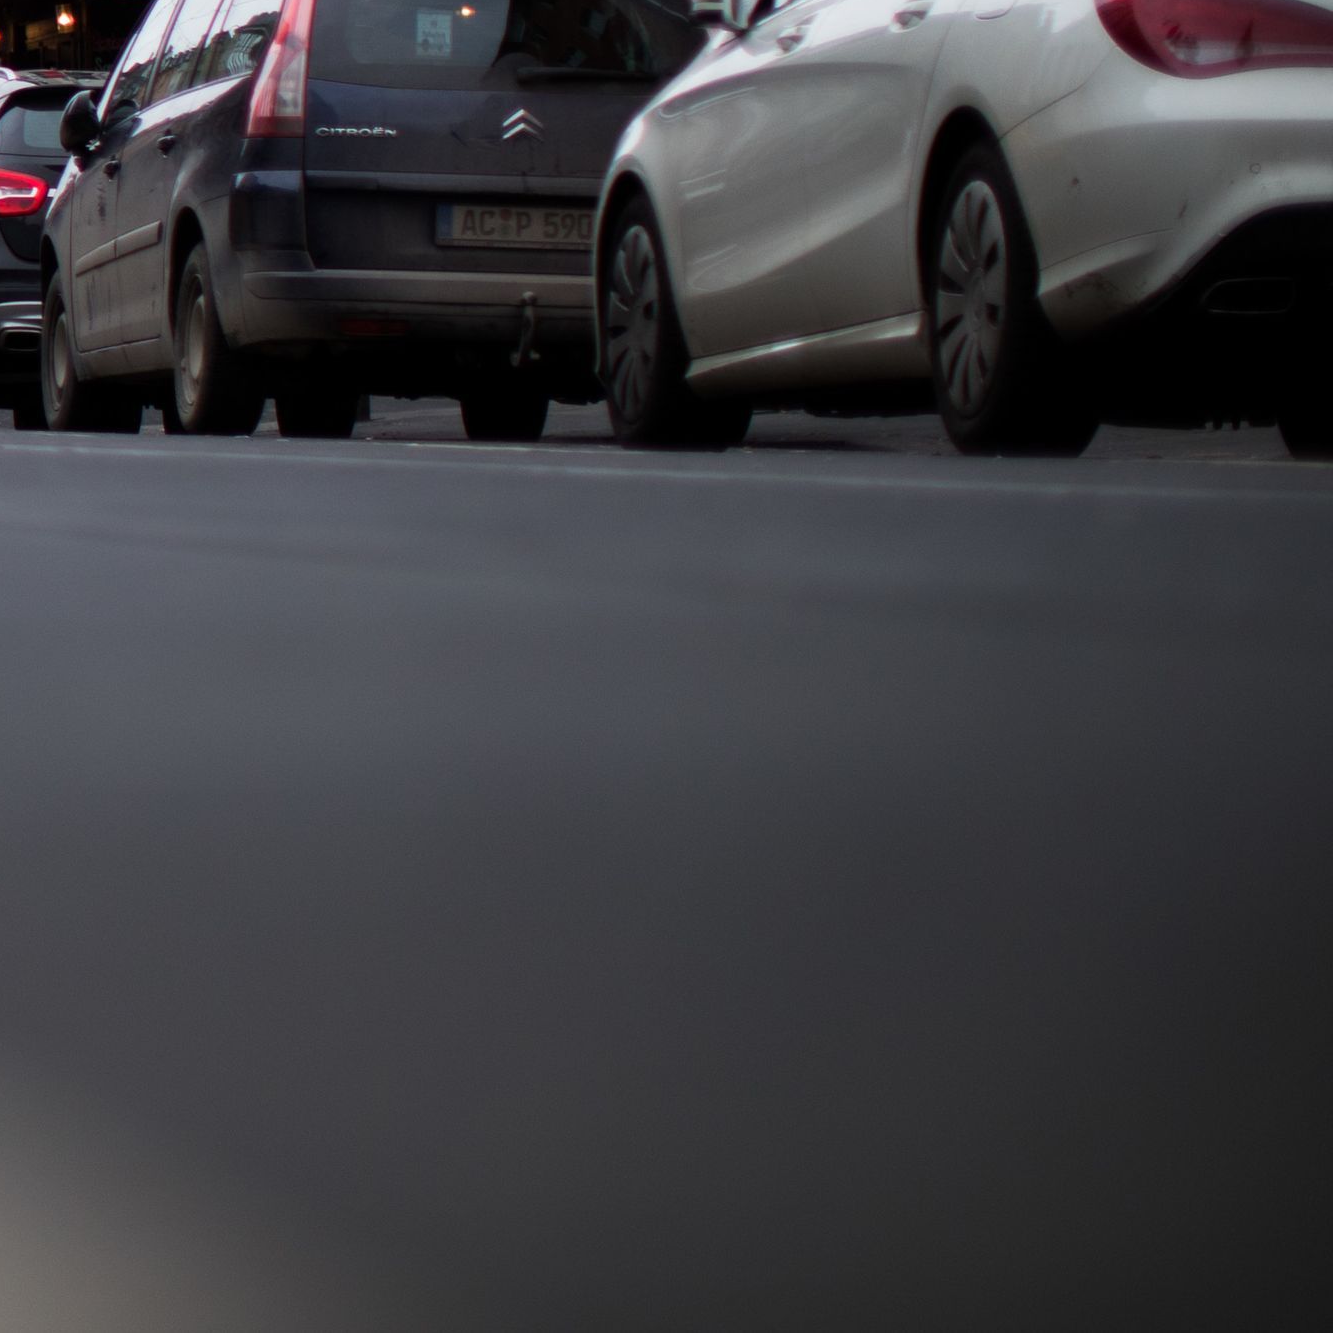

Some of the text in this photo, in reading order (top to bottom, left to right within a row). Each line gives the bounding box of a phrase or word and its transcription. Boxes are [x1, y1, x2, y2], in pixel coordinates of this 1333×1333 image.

[316, 127, 396, 137] CITROËN
[461, 209, 496, 237] AC
[515, 209, 532, 237] P
